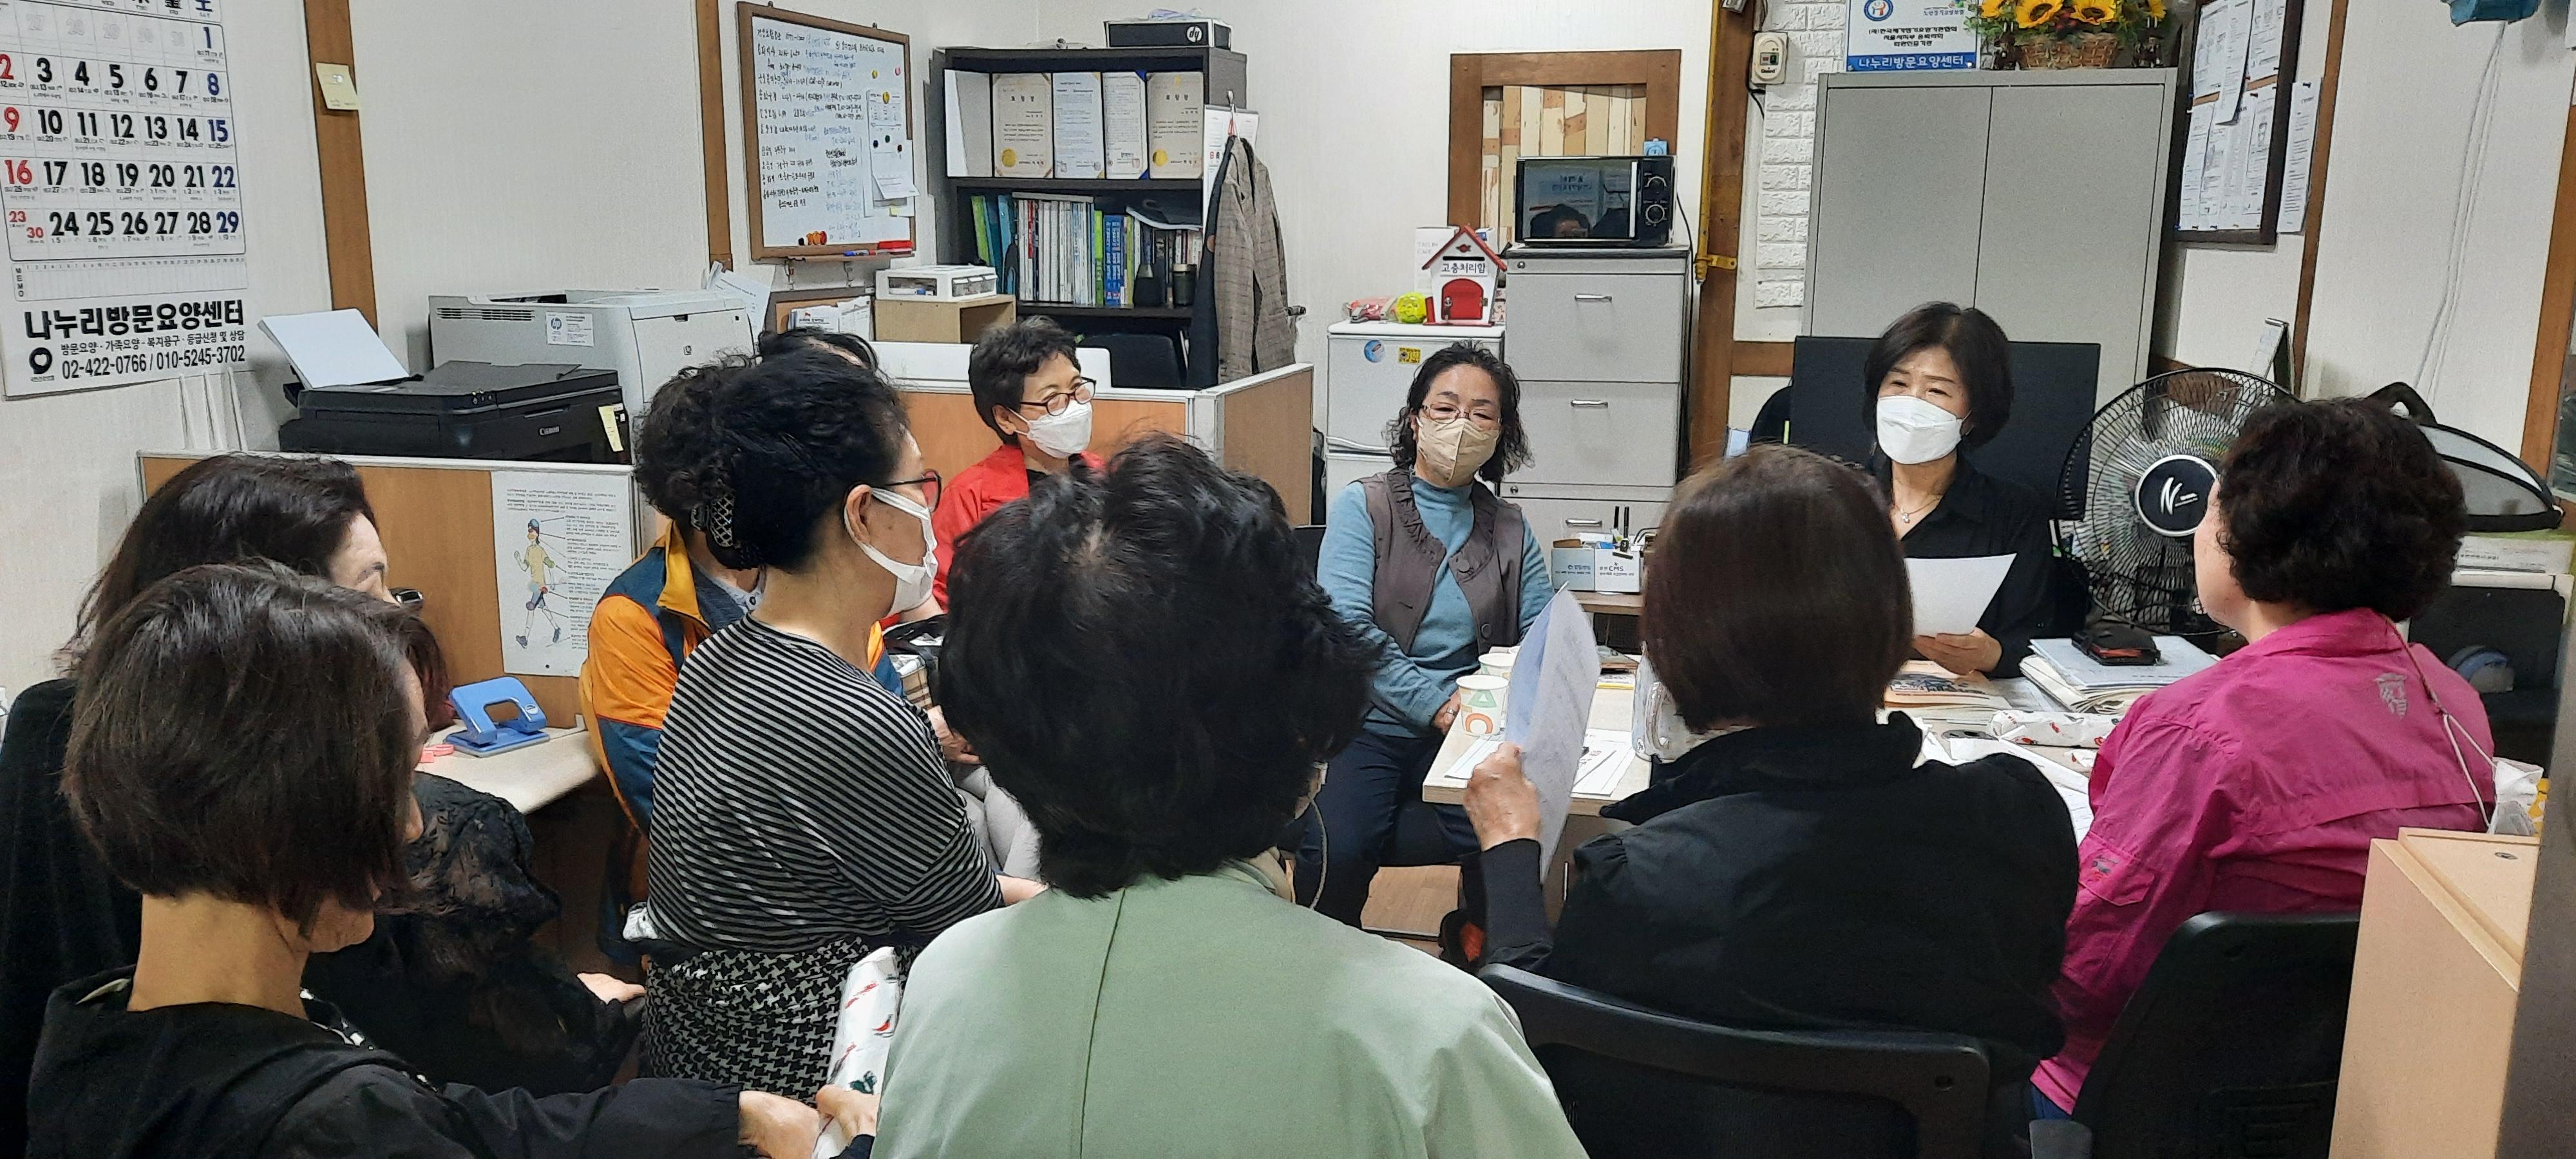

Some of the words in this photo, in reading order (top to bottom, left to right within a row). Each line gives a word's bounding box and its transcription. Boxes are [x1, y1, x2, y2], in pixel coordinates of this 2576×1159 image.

[204, 27, 211, 48] 1
[0, 54, 14, 80] 2
[37, 58, 52, 82] 3
[75, 61, 89, 86] 4
[109, 64, 124, 88] 5
[145, 68, 157, 91] 6
[176, 71, 187, 93] 7
[207, 73, 219, 95] 8
[1859, 55, 1963, 69] 나누리방문요양센터
[4, 107, 19, 132] 9
[38, 109, 62, 134] 10
[77, 112, 97, 136] 11
[111, 115, 134, 138] 12
[145, 117, 167, 139] 13
[177, 118, 198, 140] 14
[209, 120, 227, 142] 15
[5, 160, 32, 185] 16
[44, 162, 68, 185] 17
[81, 162, 105, 186] 18
[117, 164, 138, 186] 19
[149, 164, 175, 187] 20
[184, 165, 204, 187] 21
[212, 165, 235, 187] 22
[9, 211, 26, 222] 23
[50, 212, 79, 236] 24
[87, 212, 113, 235] 25
[122, 212, 147, 234] 26
[155, 212, 178, 234] 27
[187, 212, 211, 234] 28
[216, 212, 238, 232] 29
[27, 227, 43, 238] 30
[1441, 263, 1485, 274] 고충처리함
[24, 299, 244, 340] 나누리방문요양센터
[106, 338, 140, 352] 가족요양
[230, 330, 245, 341] 상담
[62, 353, 147, 379] 02-422-0766
[156, 345, 245, 370] 010-5245-3702
